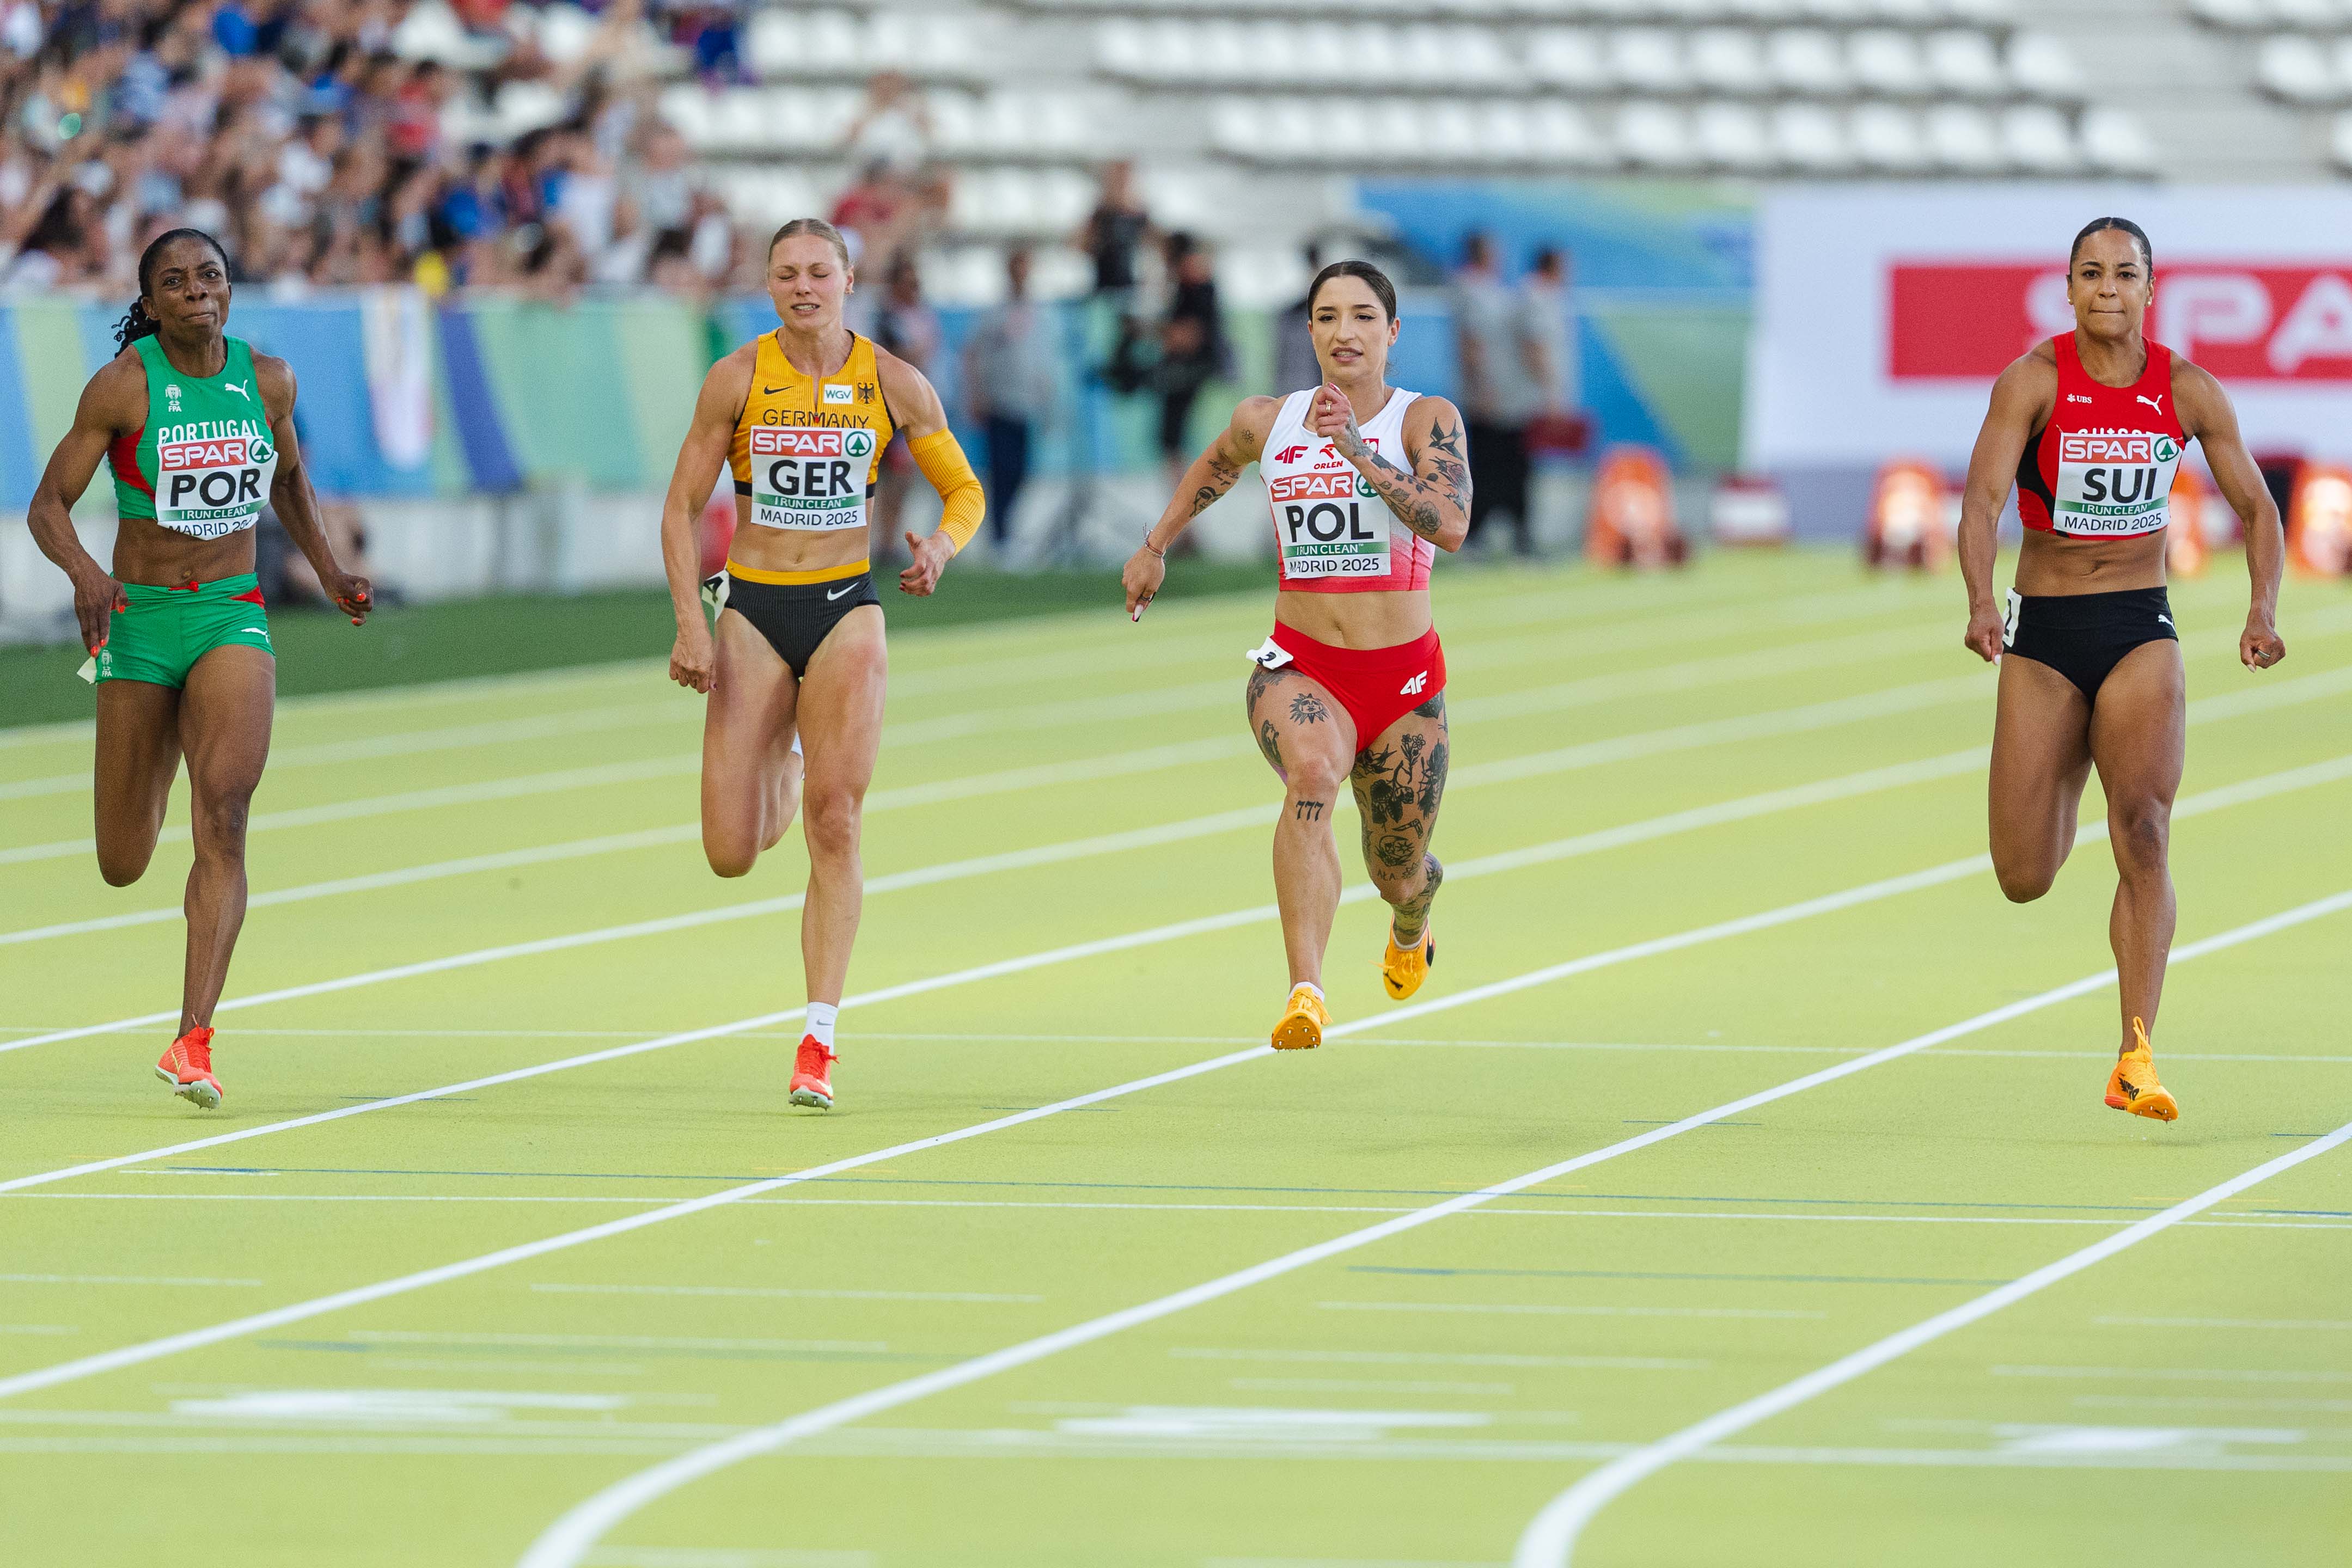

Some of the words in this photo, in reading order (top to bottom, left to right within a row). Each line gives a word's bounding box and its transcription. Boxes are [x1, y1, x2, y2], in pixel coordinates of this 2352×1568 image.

[825, 388, 852, 400] WGV
[2076, 395, 2092, 403] UBS
[763, 409, 869, 428] GERMANY
[158, 419, 264, 445] PORTUGAL
[754, 432, 840, 454] SPAR
[2064, 439, 2149, 461] SPAR
[164, 442, 245, 468] SPAR
[1274, 445, 1309, 464] 4F
[1314, 460, 1343, 470] ORLEN
[769, 459, 854, 497] GER
[1272, 475, 1351, 499] SPAR
[2082, 467, 2157, 504] SUI
[170, 469, 261, 507] POR
[775, 497, 778, 505] I
[779, 498, 804, 507] RUN
[2081, 504, 2085, 513] I
[2087, 505, 2112, 514] RUN
[181, 511, 185, 519] I
[187, 511, 211, 519] RUN
[761, 509, 822, 525] MADRID
[826, 510, 858, 525] 2025
[1285, 503, 1374, 543] POL
[2064, 516, 2128, 531] MADRID
[2131, 513, 2162, 530] 2025
[169, 523, 228, 536] MADRID
[1296, 547, 1300, 555] I
[1300, 546, 1318, 555] RUN
[1290, 560, 1337, 573] MADRID
[1342, 558, 1379, 571] 2025
[1400, 670, 1427, 695] 4F
[1295, 800, 1324, 822] 777
